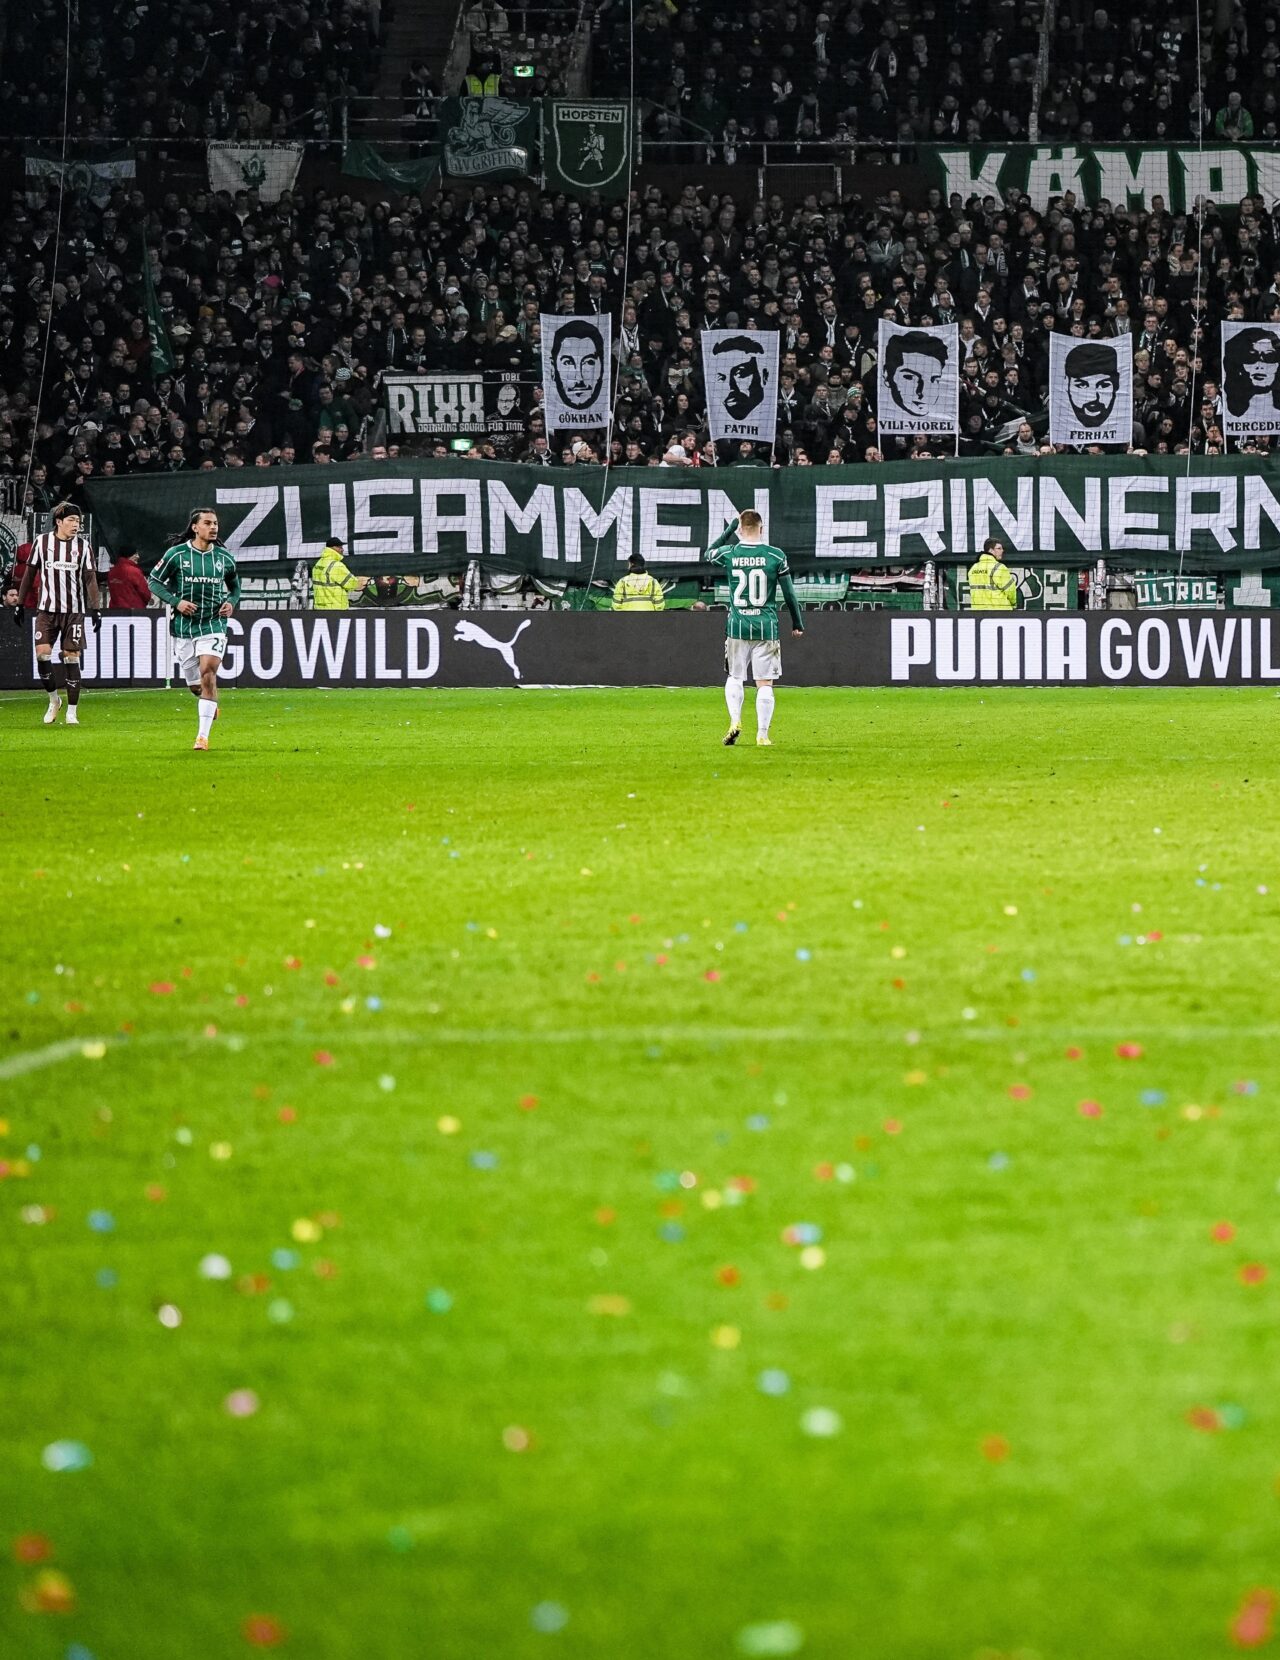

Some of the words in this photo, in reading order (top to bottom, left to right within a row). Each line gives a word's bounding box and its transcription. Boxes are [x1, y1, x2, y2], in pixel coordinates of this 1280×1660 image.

[561, 110, 620, 121] HOPSTEN
[473, 151, 525, 170] GRIFFINS
[501, 373, 521, 382] TOBI
[388, 384, 485, 433] RIXX
[558, 412, 603, 424] GÖKHAN
[724, 425, 759, 436] FATIH
[879, 421, 954, 431] VILI-VIOREL
[1070, 430, 1117, 440] FERHAT
[215, 479, 770, 562] ZUSAMMEN
[732, 557, 767, 568] WERDER
[732, 569, 768, 607] 20
[1136, 581, 1217, 603] ULTRAS
[72, 624, 82, 638] 15
[215, 617, 284, 680] GO
[290, 617, 440, 680] WILD
[891, 617, 1087, 680] PUMA
[1100, 617, 1170, 680] GO
